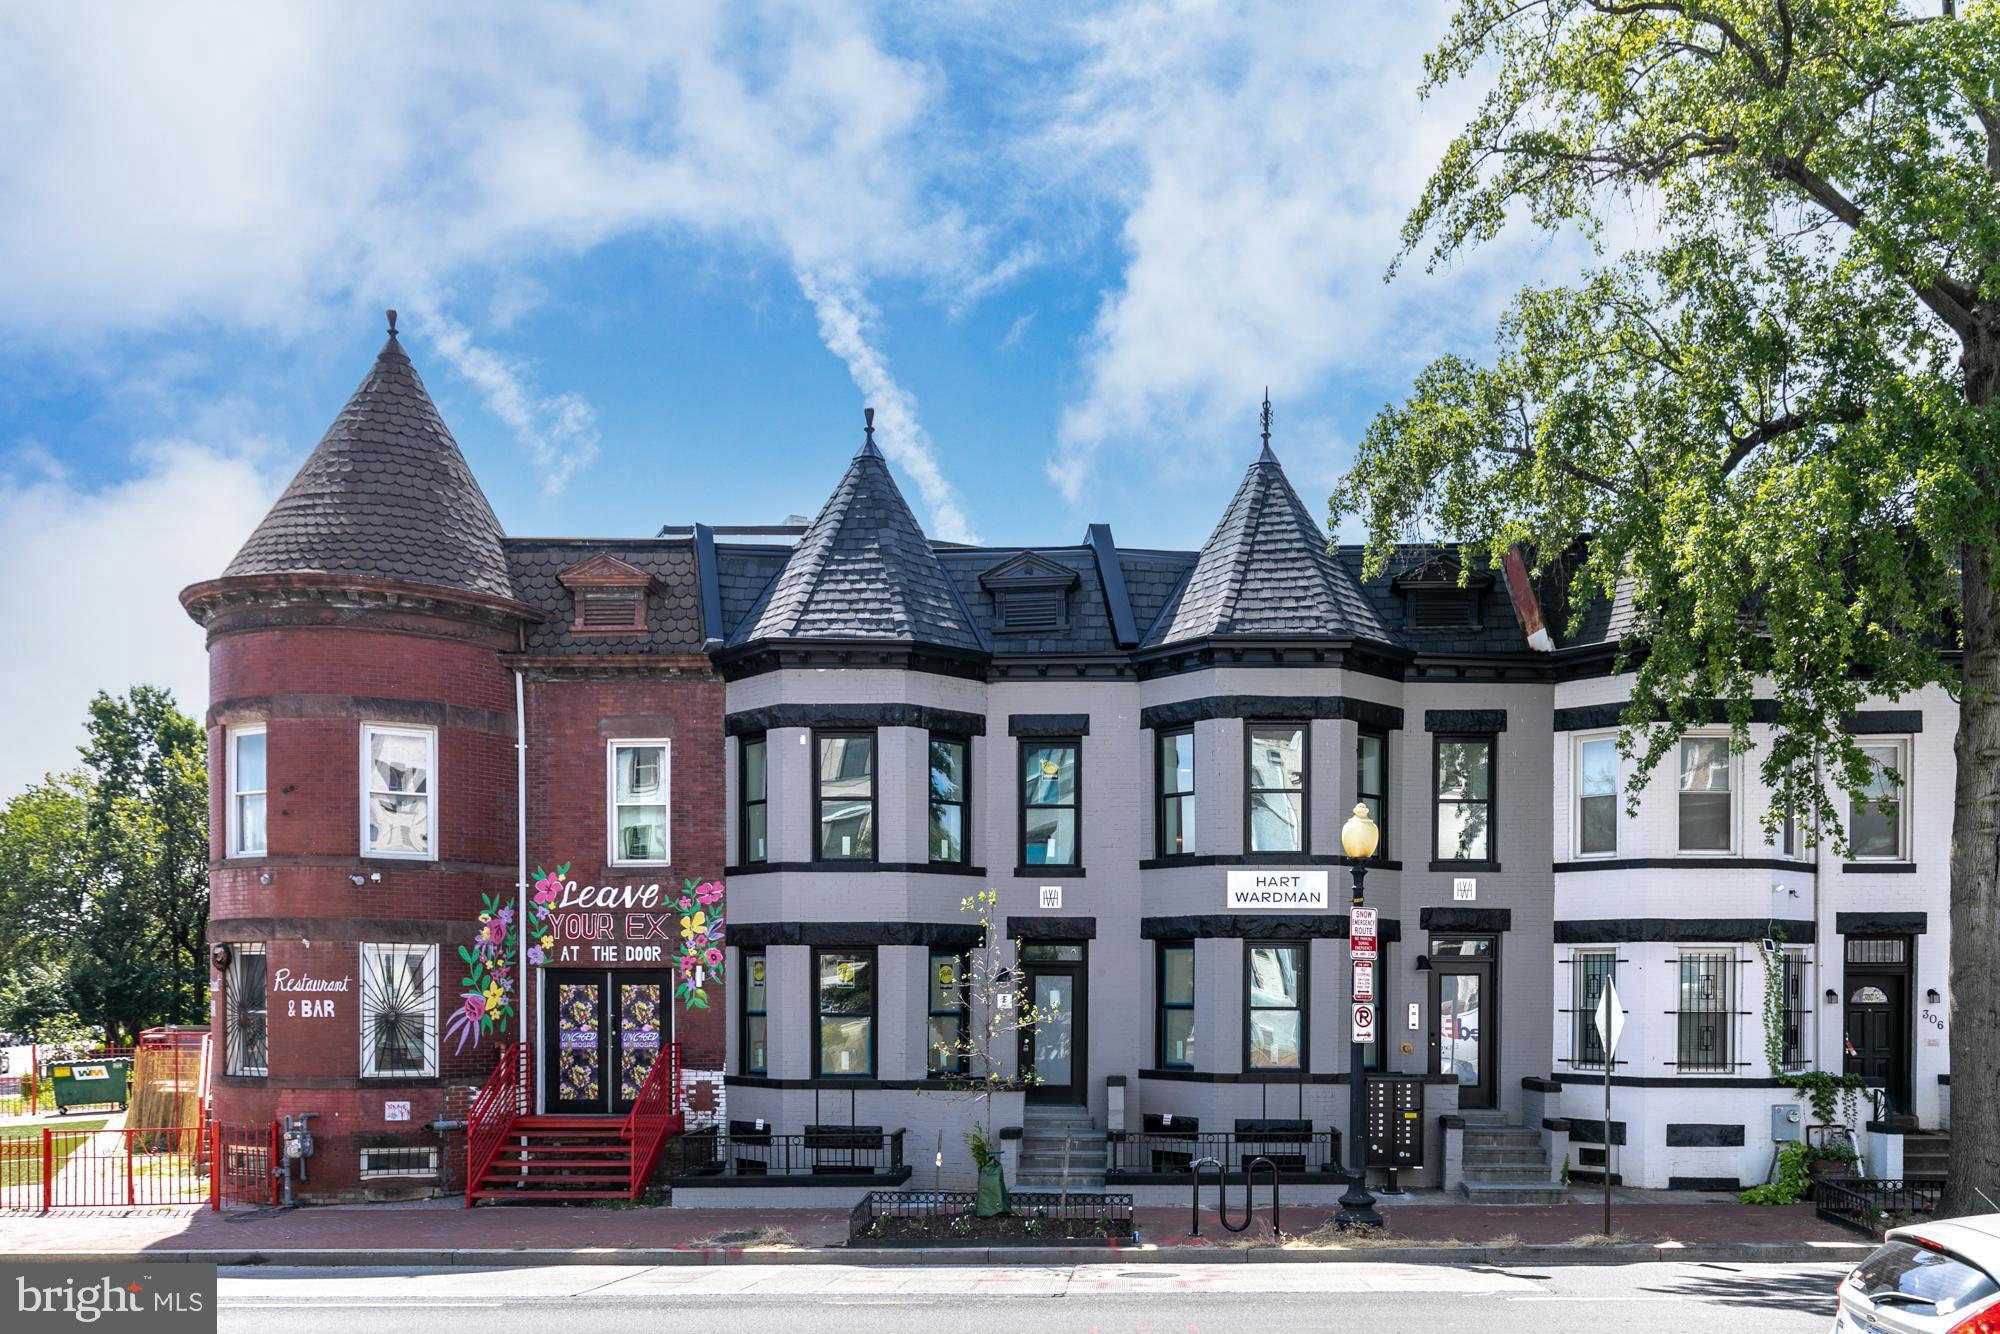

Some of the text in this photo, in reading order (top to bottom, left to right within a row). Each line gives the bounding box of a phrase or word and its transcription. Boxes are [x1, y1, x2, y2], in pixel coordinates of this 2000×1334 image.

[1256, 876, 1300, 887] HART
[559, 880, 660, 909] Leave
[1235, 892, 1321, 903] WARDMAN
[548, 913, 672, 940] YOUR EX
[1354, 927, 1373, 935] ROUTE
[560, 945, 661, 961] AT THE DOOR
[273, 968, 353, 992] Restaurant
[287, 999, 336, 1018] & BAR
[1922, 1009, 1944, 1030] 306
[561, 1032, 597, 1042] UNCAGED
[623, 1032, 659, 1042] UNCAGED
